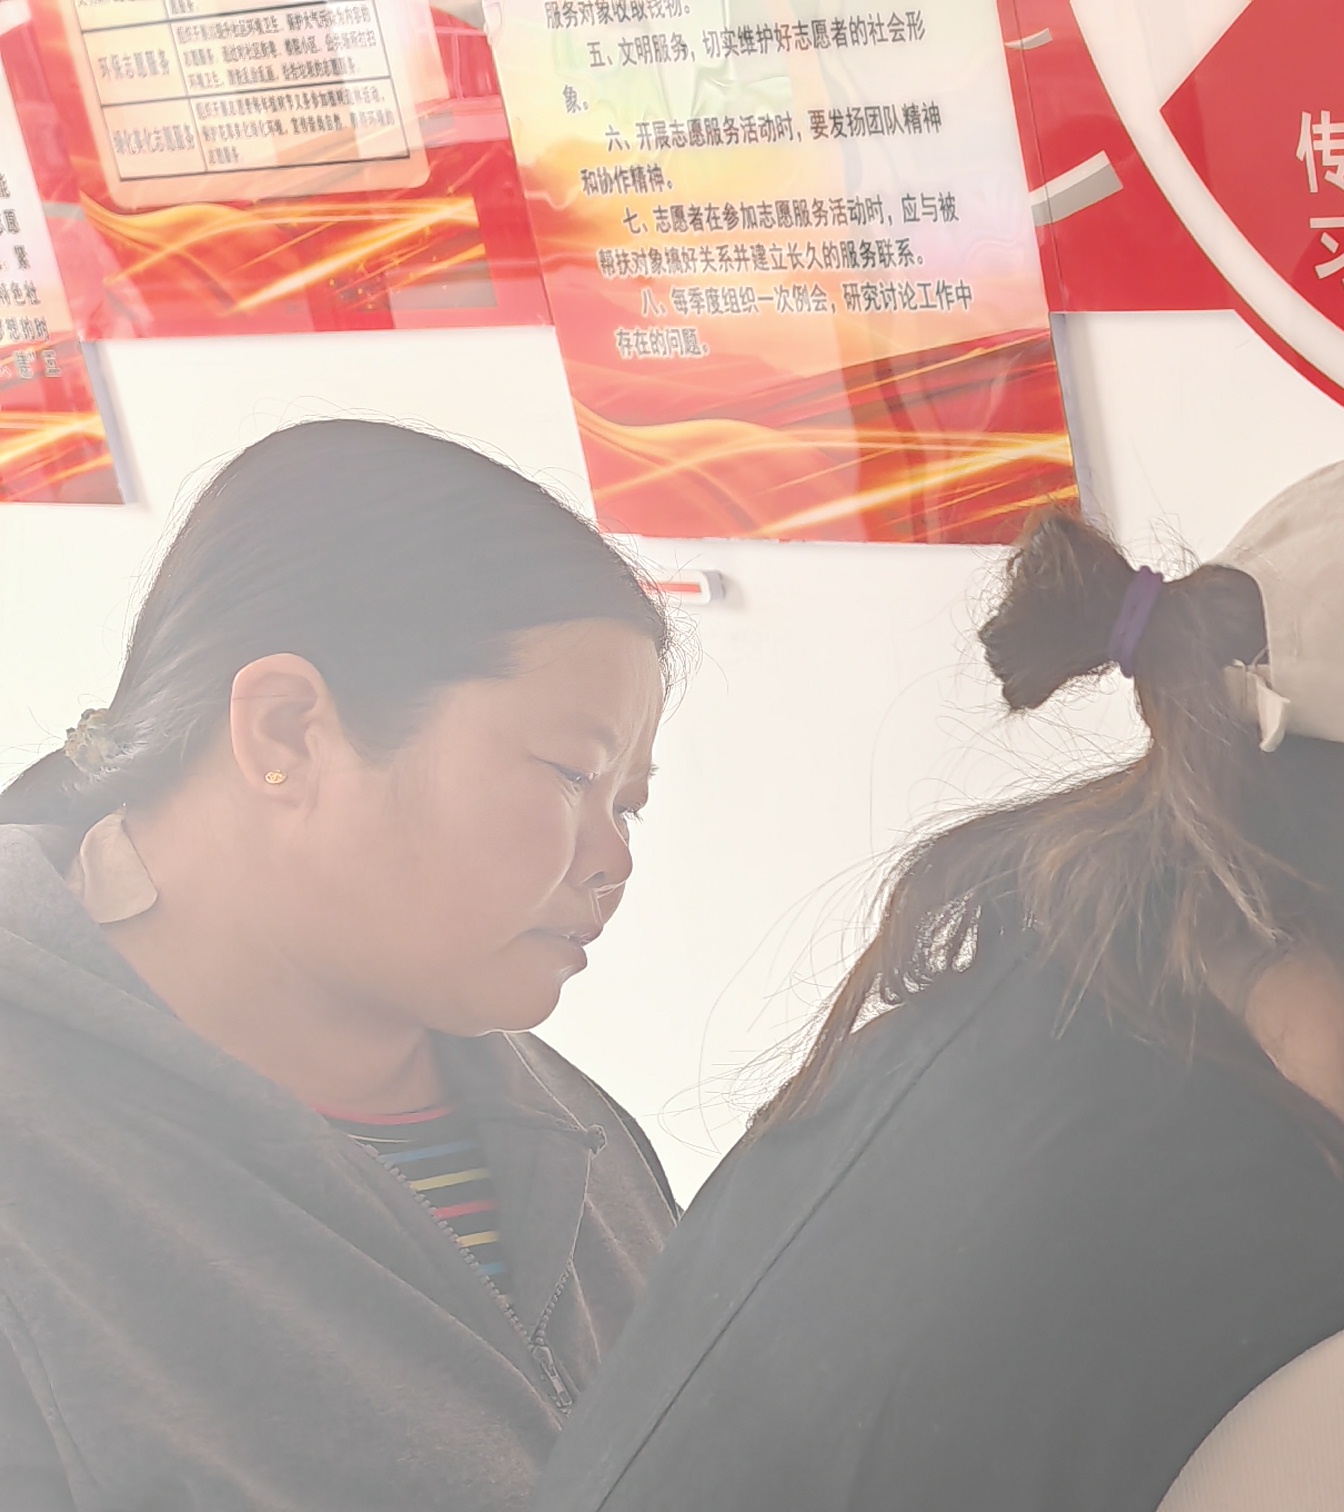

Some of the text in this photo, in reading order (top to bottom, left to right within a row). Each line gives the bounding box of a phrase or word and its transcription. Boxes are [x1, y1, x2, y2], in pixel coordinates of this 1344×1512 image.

[587, 10, 925, 68] 五、文明服务，切实维护好志愿者的社会形
[563, 84, 589, 114] 象。
[605, 101, 941, 150] 六、开展志愿服务活动时，要发扬团队精神
[581, 166, 674, 196] 和协作精神。
[624, 191, 959, 235] 七、志愿者在参加志愿服务活动时，应与被
[599, 237, 924, 278] 帮扶对象搞好关系并建立长久的服务联系。
[641, 280, 973, 318] 八、每季度组织一次例会，研究讨论工作中
[616, 328, 709, 359] 存在的问题。
